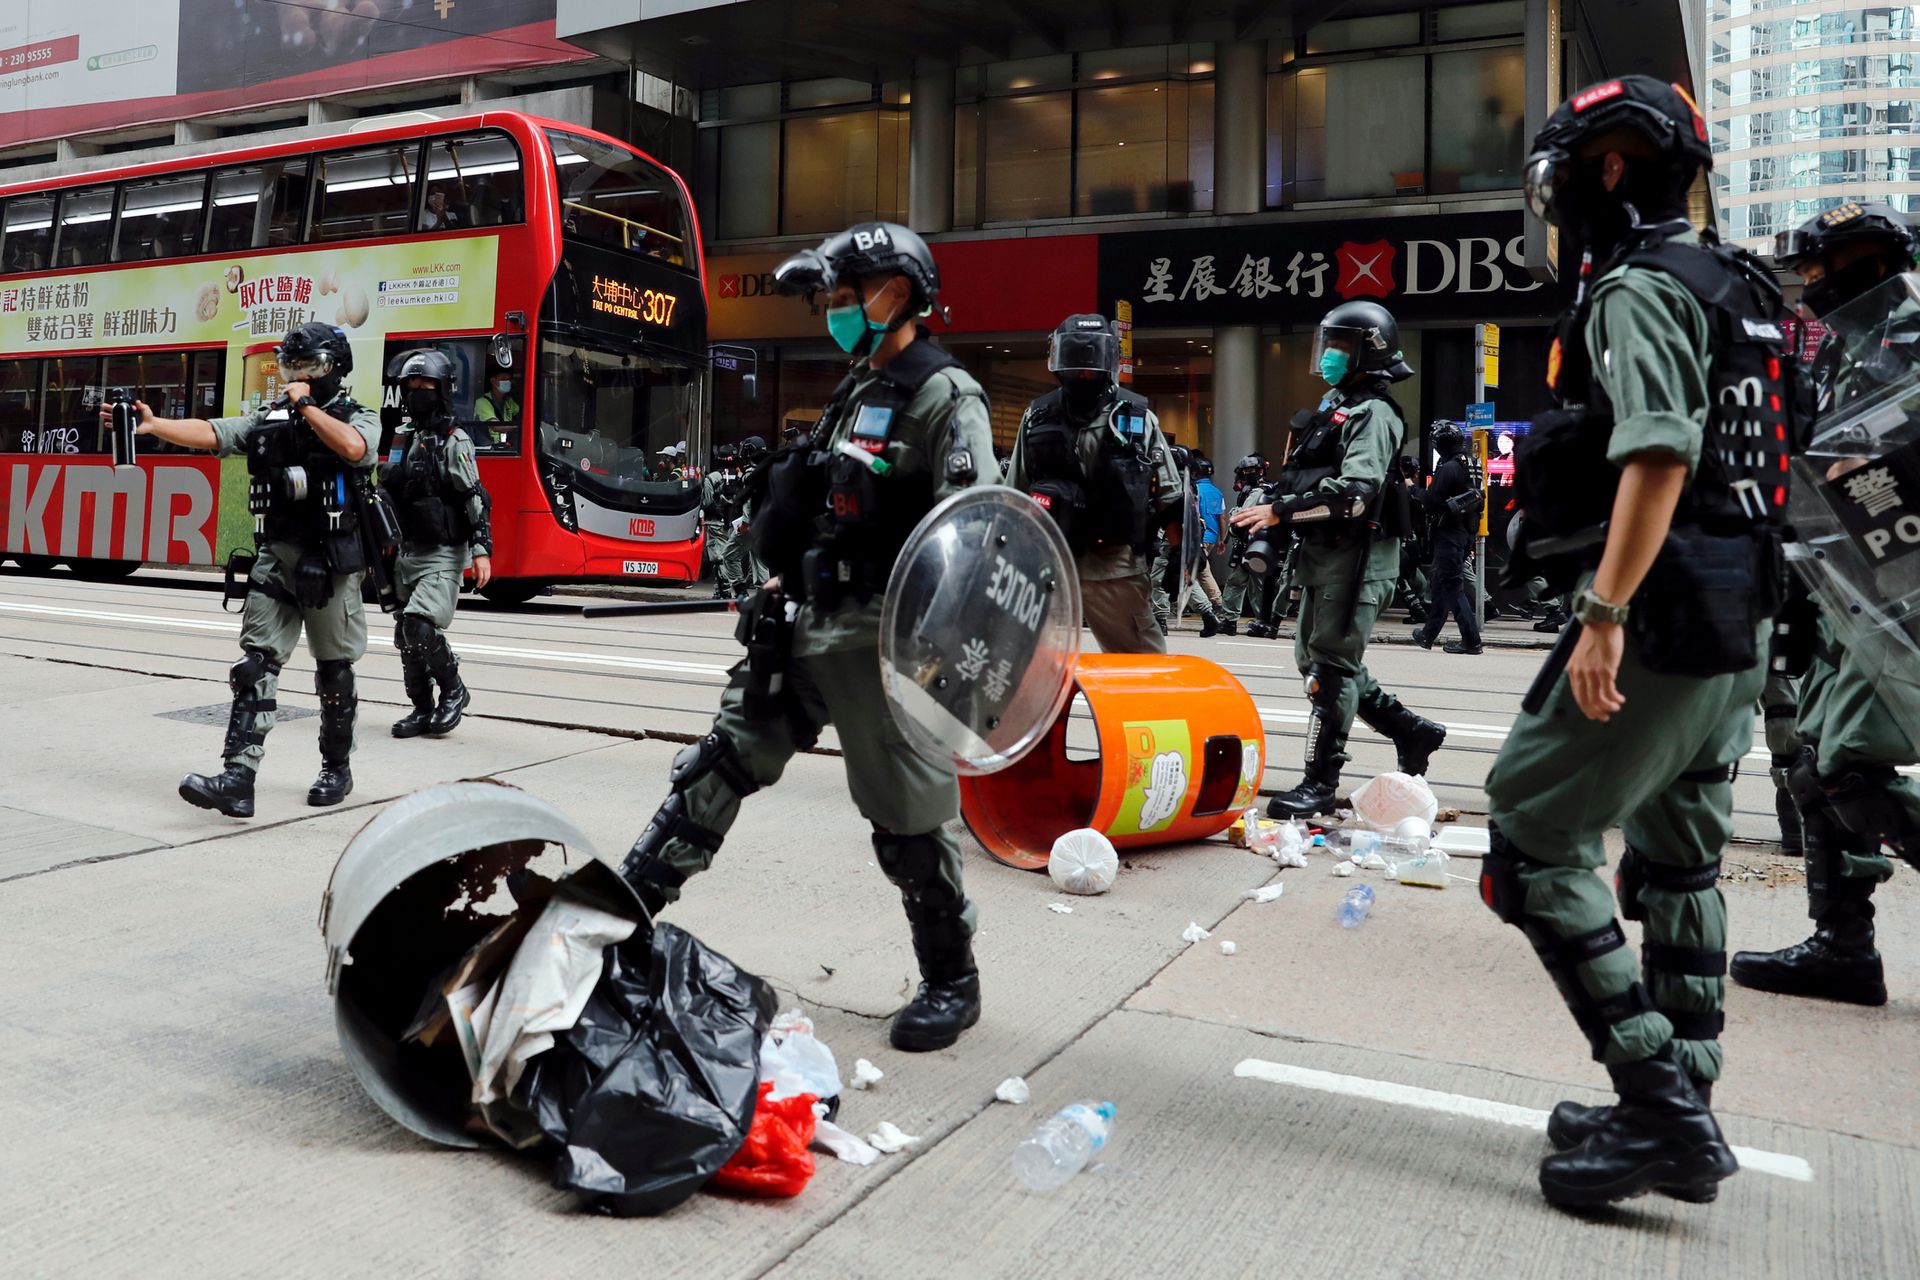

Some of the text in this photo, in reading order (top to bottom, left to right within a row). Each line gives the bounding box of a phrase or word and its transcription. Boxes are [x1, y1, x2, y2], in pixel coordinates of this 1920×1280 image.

[10, 53, 25, 66] 230
[27, 48, 52, 63] 95555
[854, 227, 888, 250] B4
[1142, 251, 1331, 303] 星展銀行
[1403, 235, 1546, 296] DBS
[0, 281, 89, 312] 記特鮮菇粉
[240, 276, 313, 309] 取代鹽糖
[592, 275, 644, 309] 大埔中心
[643, 289, 676, 327] 307
[592, 299, 639, 321] TAI PO CENTRAL
[1843, 466, 1904, 518] 警
[624, 561, 657, 574] VS 3709
[986, 554, 1046, 632] POLICE
[955, 637, 1012, 703] 警察
